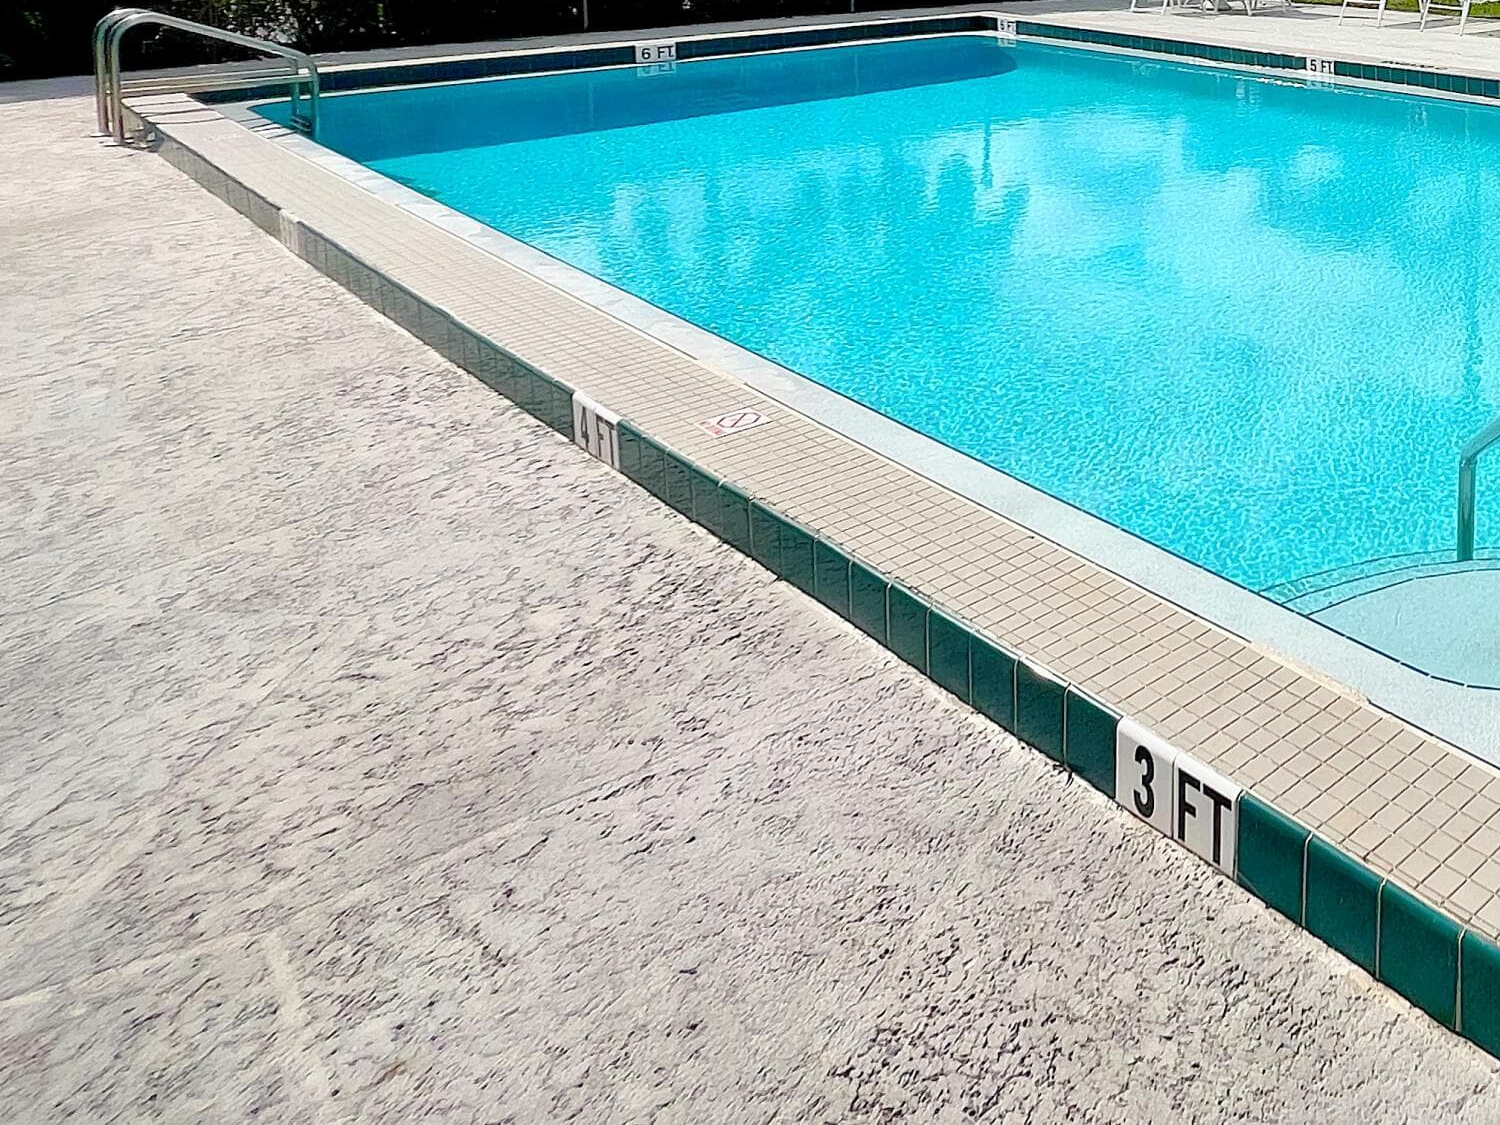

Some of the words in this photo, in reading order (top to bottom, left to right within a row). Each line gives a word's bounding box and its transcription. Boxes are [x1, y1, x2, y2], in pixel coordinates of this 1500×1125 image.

[641, 47, 651, 60] 6
[1310, 59, 1317, 72] 5
[581, 406, 589, 451] 4
[595, 413, 615, 466] FT
[1133, 745, 1155, 818] 3
[1177, 767, 1233, 867] FT
